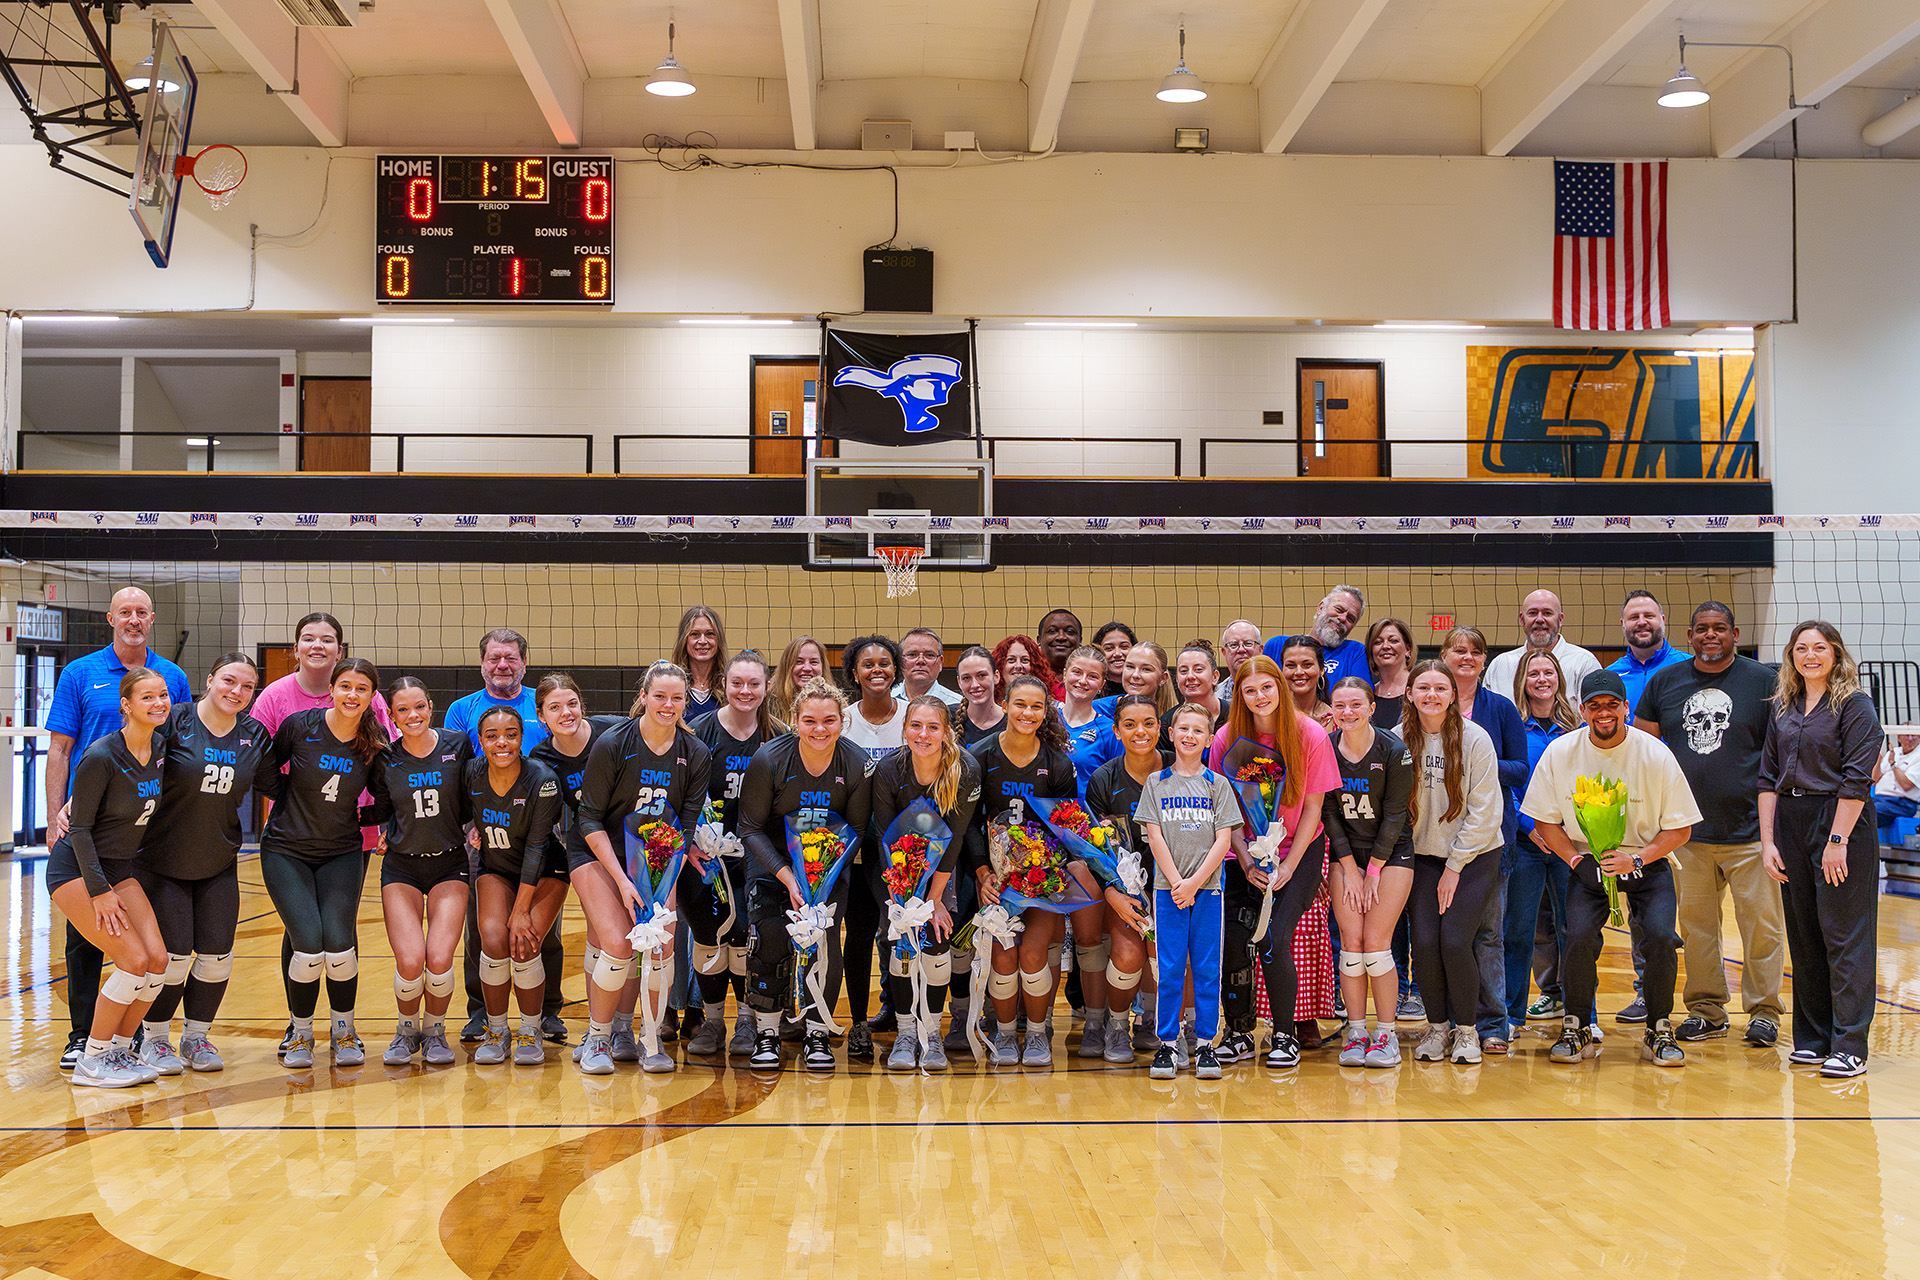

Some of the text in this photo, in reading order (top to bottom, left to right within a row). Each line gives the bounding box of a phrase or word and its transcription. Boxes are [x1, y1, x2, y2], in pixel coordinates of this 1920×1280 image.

[381, 161, 432, 176] HOME
[553, 161, 610, 177] GUEST
[483, 159, 545, 200] 1:15
[409, 179, 432, 219] 0
[586, 179, 608, 220] 0
[478, 203, 510, 211] PERIOD
[421, 227, 454, 237] BONUS
[535, 228, 568, 237] BONUS
[377, 245, 414, 254] FOULS
[473, 245, 515, 255] PLAYER
[574, 245, 611, 255] FOULS
[386, 256, 409, 296] 0
[513, 258, 520, 296] 1
[584, 257, 607, 297] 0
[31, 512, 57, 522] NAIA
[137, 513, 160, 522] SMC
[190, 513, 217, 523] NAIA
[297, 514, 319, 523] SMC
[350, 515, 376, 524] NAIA
[456, 516, 478, 524] SMC
[509, 516, 536, 526] NAIA
[614, 517, 637, 525] SMC
[668, 516, 694, 526] NAIA
[772, 517, 795, 526] SMC
[826, 517, 852, 527] NAIA
[1553, 517, 1575, 526] SMC
[1605, 517, 1630, 527] NAIA
[1707, 516, 1729, 525] SMC
[1758, 516, 1784, 526] NAIA
[1860, 516, 1882, 524] SMC
[930, 518, 952, 527] SMC
[983, 518, 1009, 528] NAIA
[1087, 518, 1109, 527] SMC
[1139, 518, 1165, 528] NAIA
[1243, 518, 1265, 527] SMC
[1295, 518, 1321, 528] NAIA
[1398, 518, 1420, 527] SMC
[1450, 518, 1476, 528] NAIA
[1433, 616, 1451, 631] EXIT
[204, 748, 236, 764] SMC
[319, 754, 354, 773] SMC
[200, 764, 235, 794] 28
[408, 771, 442, 788] SMC
[567, 770, 586, 789] SM
[640, 769, 671, 786] SMC
[137, 779, 161, 797] SMC
[321, 774, 341, 802] 4
[1001, 781, 1034, 797] SMC
[1340, 778, 1369, 792] SMC
[413, 789, 440, 818] 13
[635, 787, 668, 816] 23
[800, 791, 831, 806] SMC
[1341, 793, 1375, 819] 24
[135, 799, 156, 825] 2
[1008, 798, 1024, 825] 3
[1162, 807, 1215, 822] NATION
[482, 808, 511, 827] SMC
[796, 807, 829, 830] 25
[485, 825, 511, 849] 10
